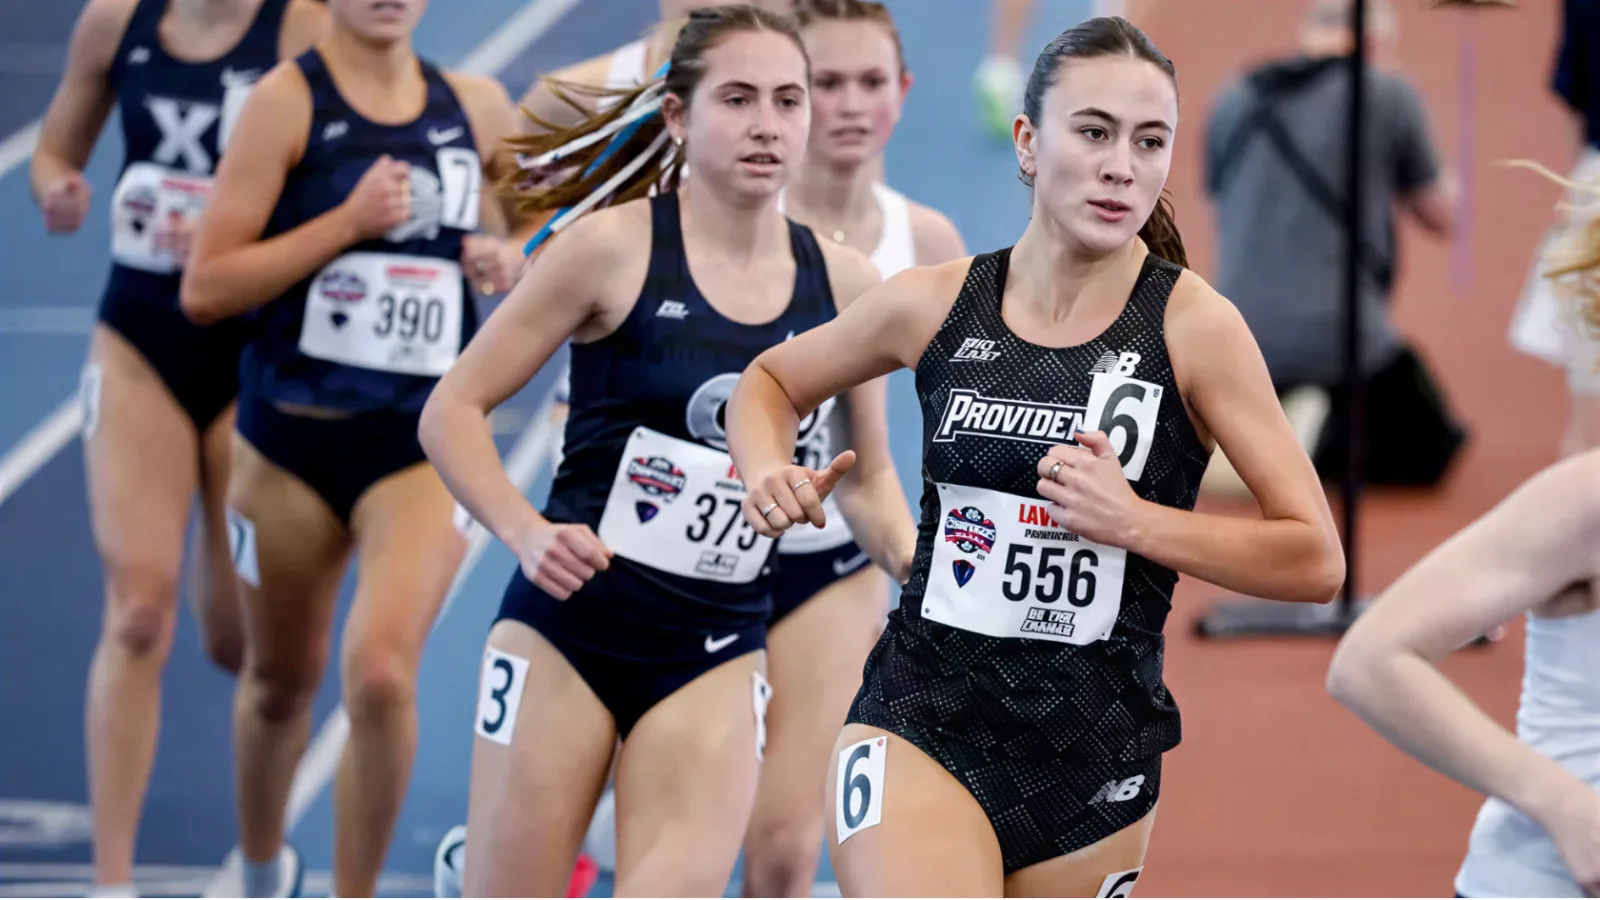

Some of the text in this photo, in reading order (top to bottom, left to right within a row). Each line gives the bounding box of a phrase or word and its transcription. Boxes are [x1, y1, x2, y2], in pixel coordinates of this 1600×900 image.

[145, 96, 219, 173] X
[374, 293, 444, 344] 390
[1100, 382, 1147, 469] 6
[1002, 542, 1099, 608] 556
[483, 658, 514, 734] 3
[842, 744, 871, 829] 6
